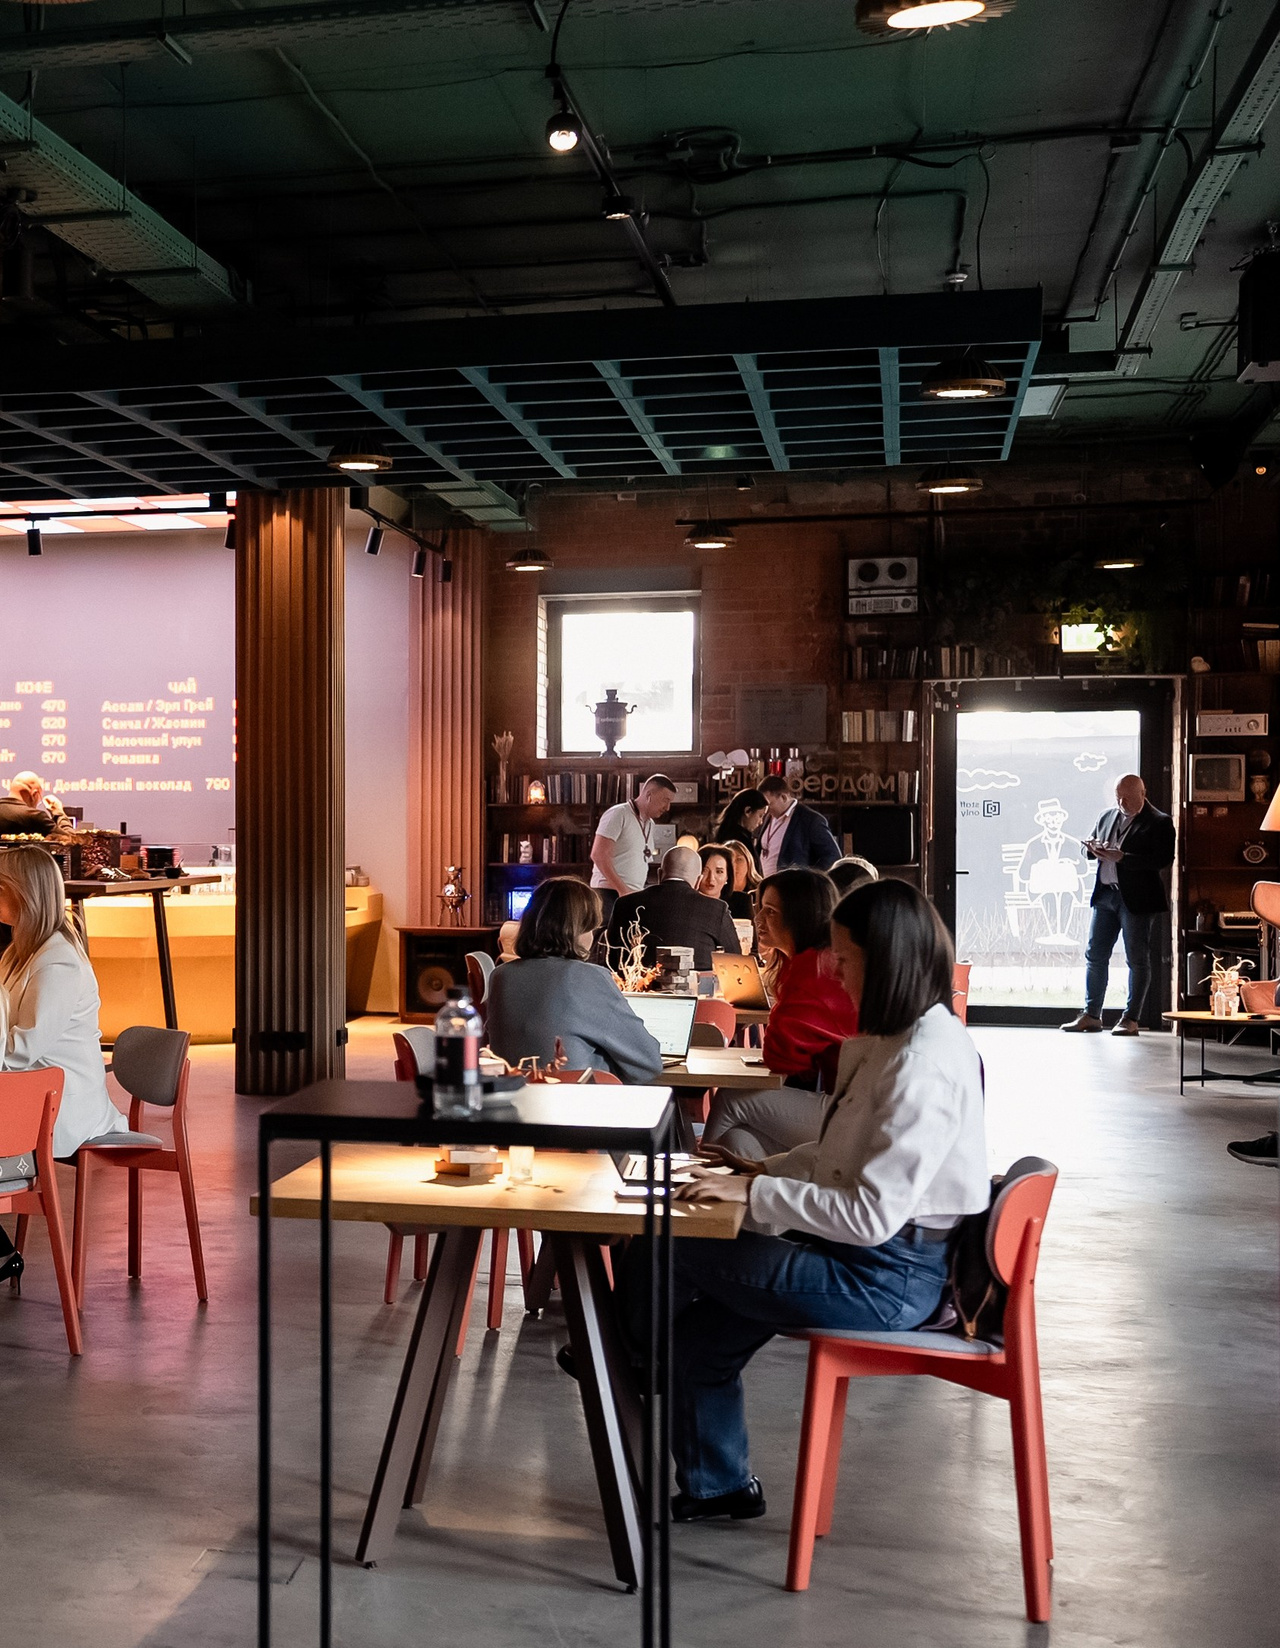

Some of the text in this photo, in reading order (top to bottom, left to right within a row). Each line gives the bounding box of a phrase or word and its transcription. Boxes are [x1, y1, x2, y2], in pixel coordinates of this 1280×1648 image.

[15, 681, 53, 694] КОФЕ
[167, 677, 197, 694] ЧАЙ
[40, 700, 66, 713] 470
[101, 701, 145, 713] Ассам
[155, 700, 181, 715] Эрл
[183, 697, 214, 714] Грей
[101, 718, 142, 730] Сенча
[151, 717, 206, 730] Жасмин
[102, 733, 202, 749] Молочный улун
[102, 752, 160, 765] Ромашка
[53, 777, 133, 793] Домбайский
[135, 780, 193, 793] шоколад
[744, 765, 895, 798] бердом
